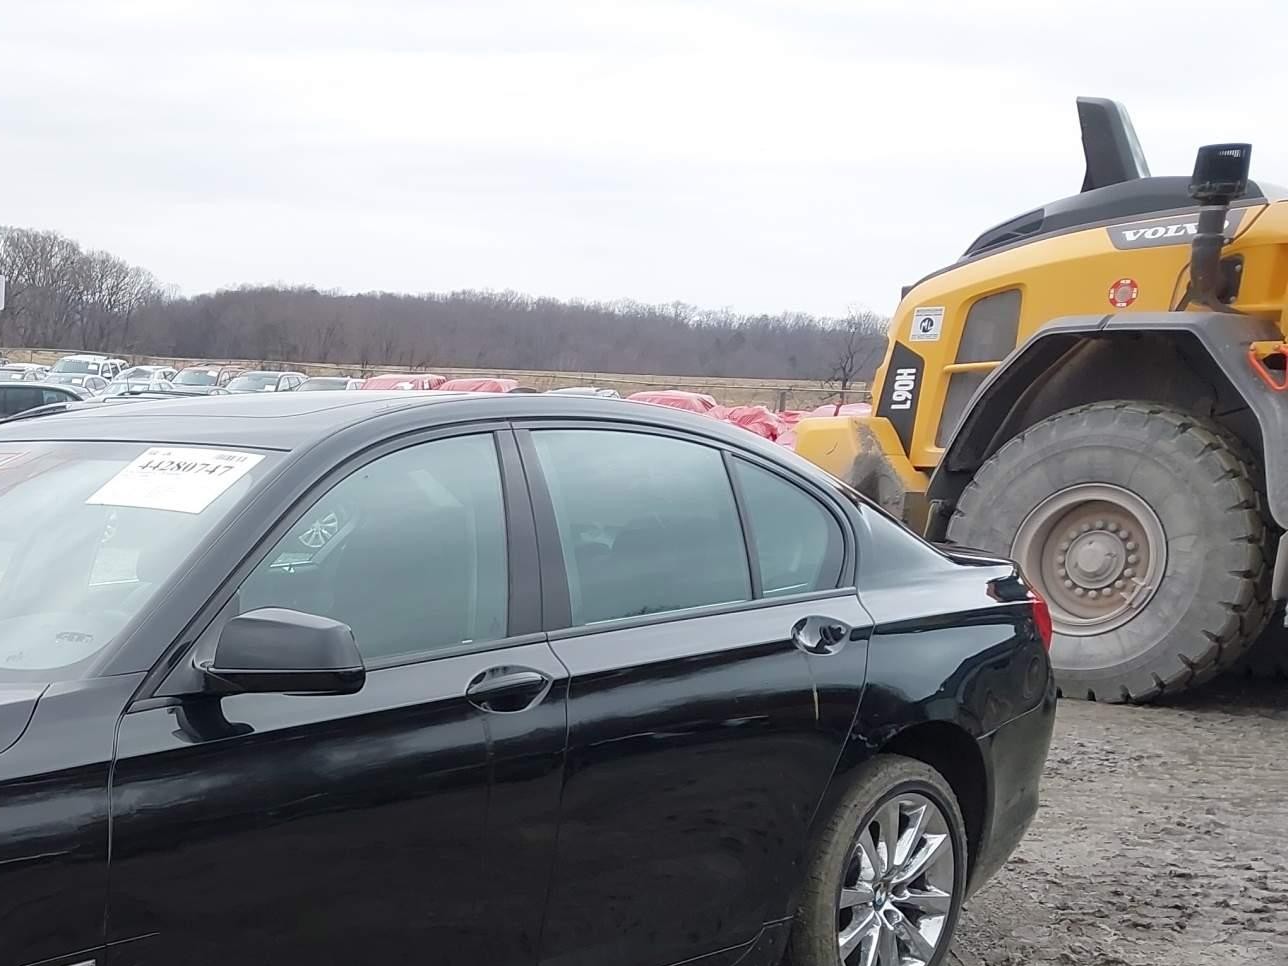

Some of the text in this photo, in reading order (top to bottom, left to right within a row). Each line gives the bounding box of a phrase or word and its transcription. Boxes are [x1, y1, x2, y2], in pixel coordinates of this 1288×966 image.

[1122, 220, 1230, 241] VOLV
[890, 368, 917, 410] L90H
[138, 459, 234, 476] 44280747
